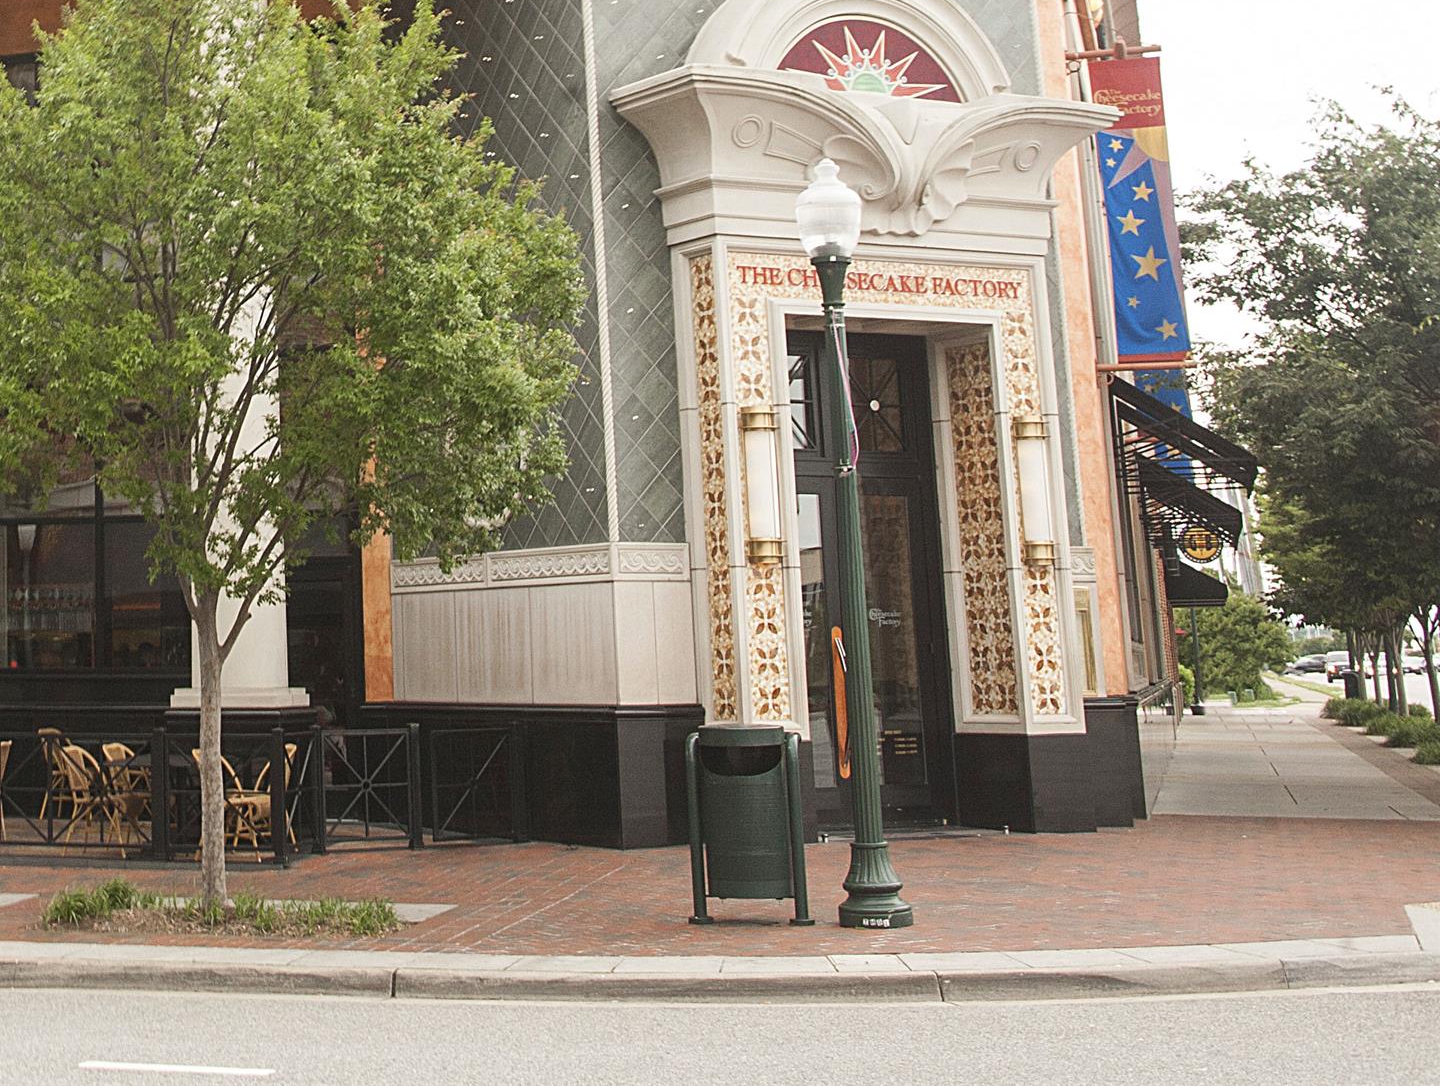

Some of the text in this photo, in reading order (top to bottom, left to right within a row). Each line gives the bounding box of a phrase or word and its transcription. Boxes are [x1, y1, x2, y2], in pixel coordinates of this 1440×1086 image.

[1106, 100, 1162, 117] actory
[736, 265, 1023, 300] THE CHSECAKE FACTORY
